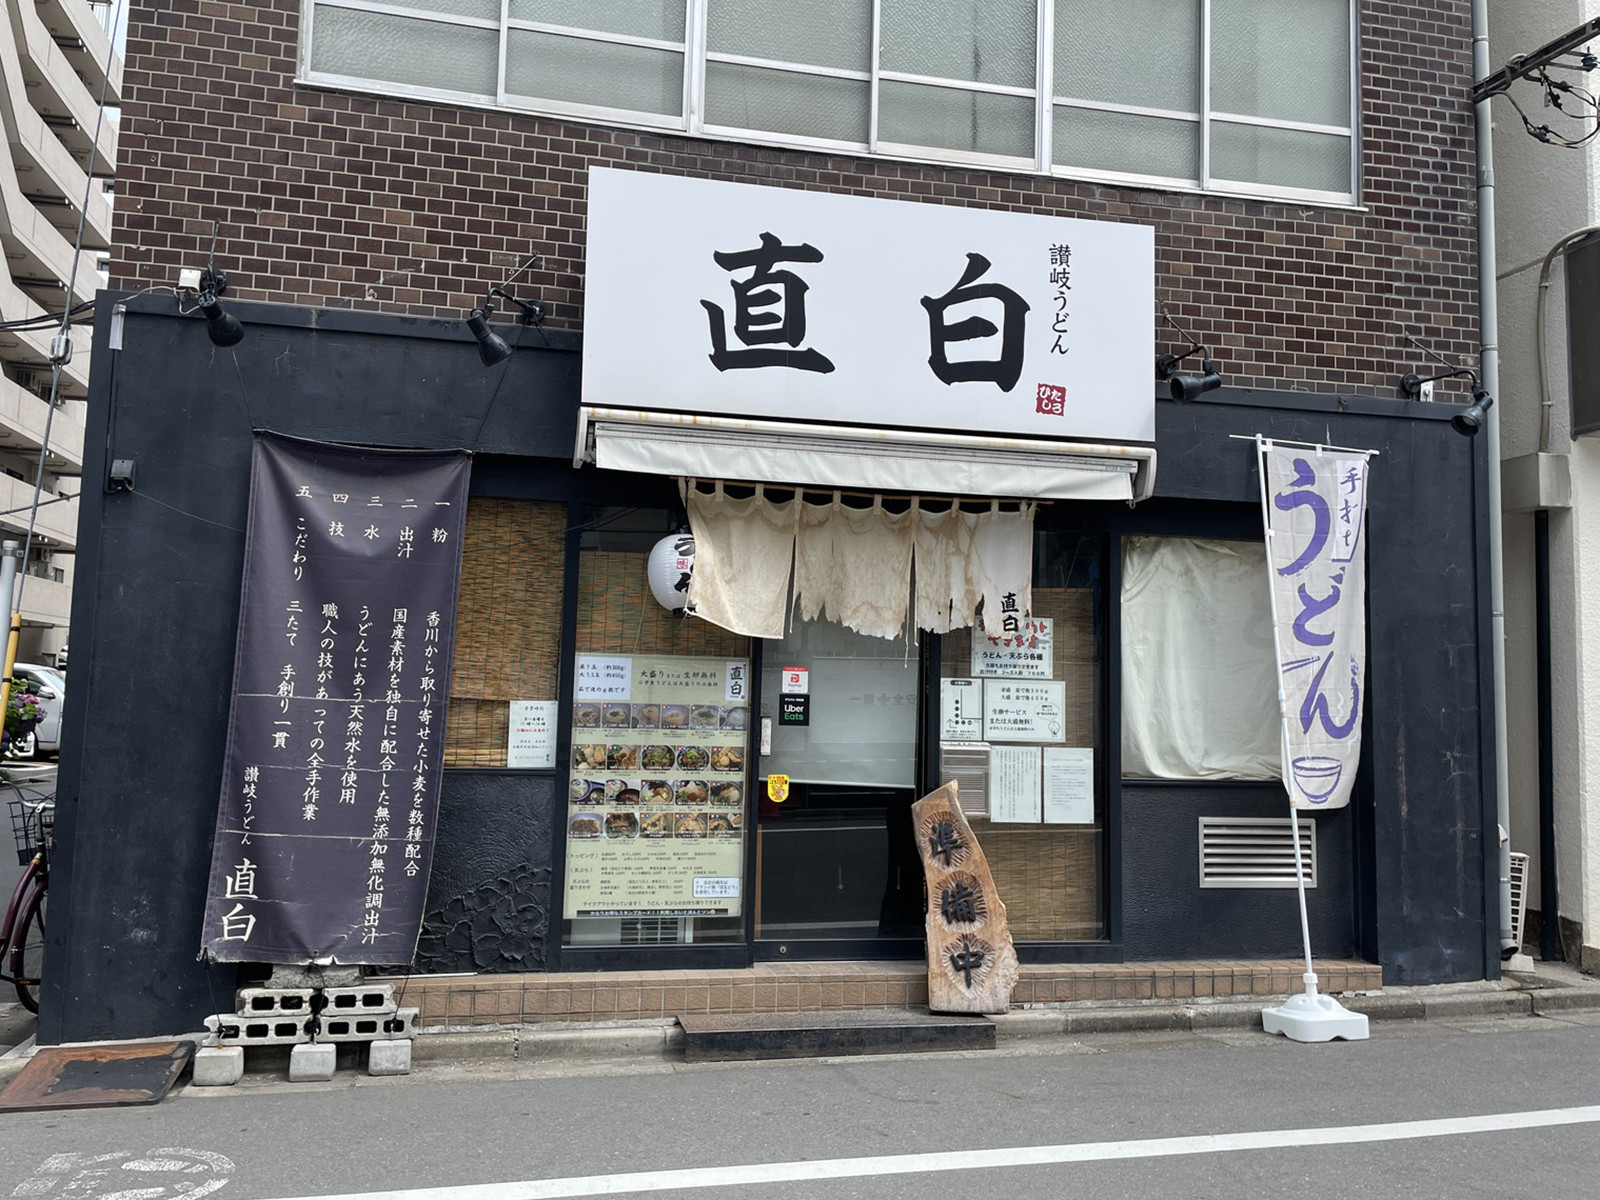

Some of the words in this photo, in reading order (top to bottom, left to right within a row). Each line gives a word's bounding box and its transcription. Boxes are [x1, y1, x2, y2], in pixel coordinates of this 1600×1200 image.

[700, 231, 1030, 392] 直白
[1048, 243, 1072, 355] 讃岐うどん
[295, 485, 313, 499] 五
[332, 492, 349, 504] 四
[366, 495, 383, 508] 三
[401, 498, 418, 509] 二
[292, 517, 308, 582] こだわり
[328, 520, 346, 538] 技
[363, 524, 380, 540] 水
[397, 526, 415, 559] 出汁
[431, 526, 449, 544] 粉
[286, 599, 304, 647] 三たて
[1001, 591, 1020, 633] 直白
[1274, 457, 1359, 740] うどん
[271, 663, 296, 749] 手創り一貫
[339, 604, 373, 805] うどんにあう天然水を使用
[730, 666, 743, 695] 直白
[784, 704, 805, 713] Uber
[301, 602, 339, 821] 職人の技があっての全手作業
[403, 610, 441, 877] 香川から取り寄せた小麦を数種配合
[361, 607, 409, 945] 国産素材を独自に配合した無添加無化調出汁
[241, 765, 260, 846] 讃岐うどん
[221, 857, 259, 942] 直白
[929, 820, 985, 989] 準備中
